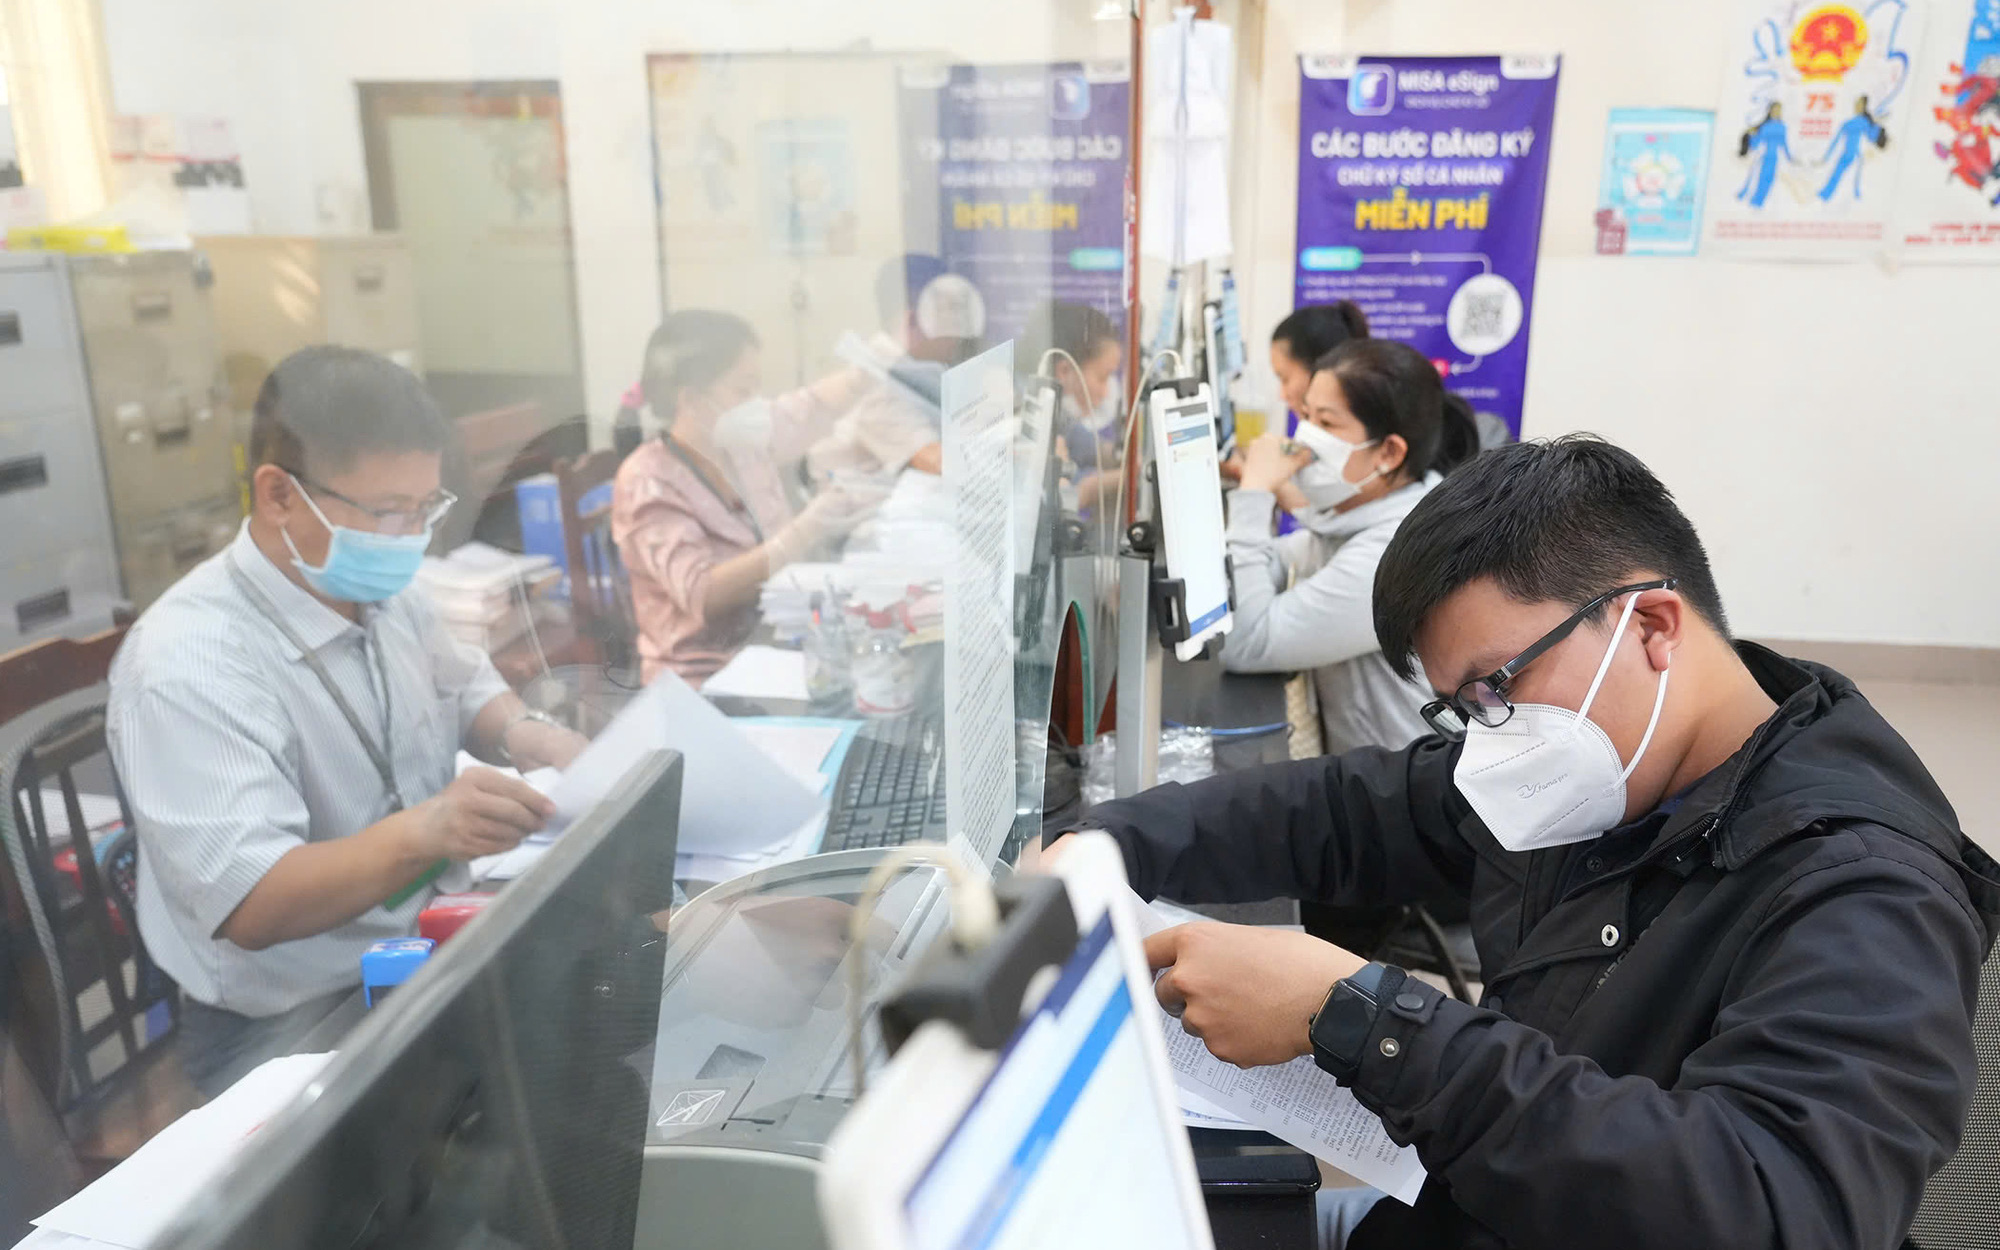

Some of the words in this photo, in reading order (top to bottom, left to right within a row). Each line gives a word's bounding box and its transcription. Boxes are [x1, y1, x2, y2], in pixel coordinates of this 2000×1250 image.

[1398, 71, 1444, 91] MISA
[1447, 71, 1499, 96] eSign
[1311, 127, 1361, 158] CÁC
[1362, 127, 1429, 158] BƯỚC
[1430, 127, 1499, 158] ĐĂNG
[1501, 126, 1535, 157] KÝ
[1355, 187, 1431, 230] MIỄN
[1434, 192, 1489, 230] PHÍ
